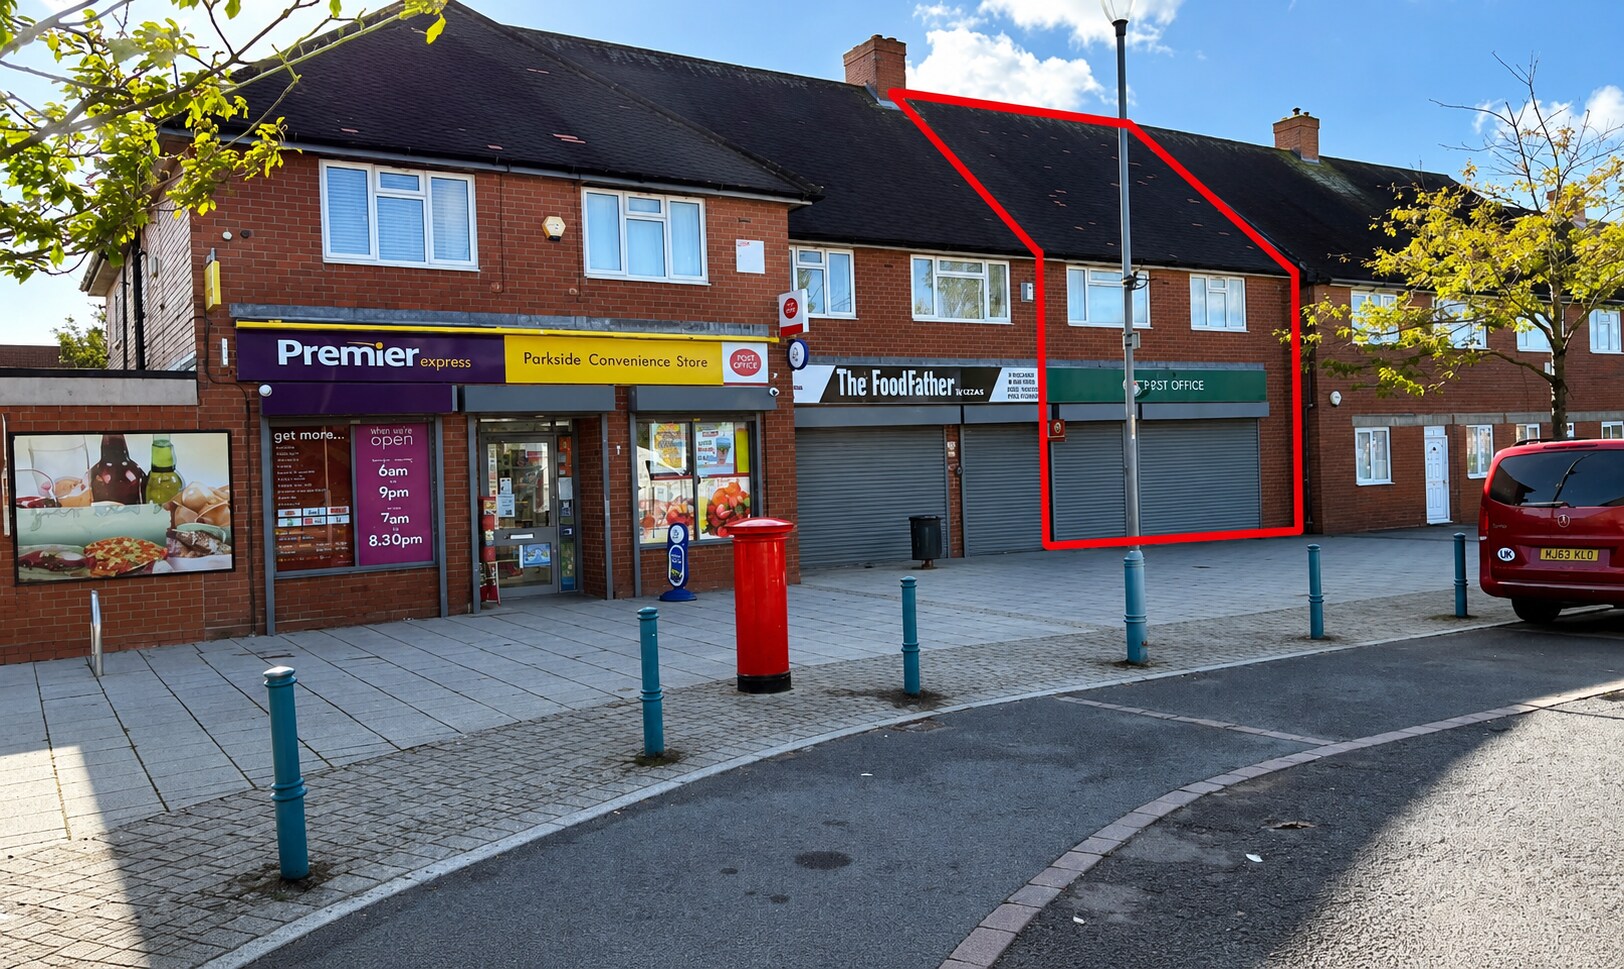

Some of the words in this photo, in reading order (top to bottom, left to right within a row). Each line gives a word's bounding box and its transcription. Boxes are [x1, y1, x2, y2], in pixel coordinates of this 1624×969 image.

[277, 339, 420, 367] Premier
[420, 356, 472, 371] express
[523, 351, 581, 367] Parkside
[588, 353, 671, 368] Convenience
[676, 355, 708, 368] Store
[737, 354, 755, 362] POST
[733, 361, 758, 370] OFFICE
[836, 368, 867, 397] The
[871, 369, 955, 397] FoodFather
[1171, 379, 1204, 391] OFFICE
[274, 431, 296, 443] get
[300, 430, 345, 441] more...
[370, 426, 390, 435] when
[371, 435, 413, 450] open
[378, 464, 408, 477] 6am
[379, 486, 409, 501] 9pm
[380, 512, 410, 525] 7am
[369, 533, 423, 549] 8.30pm
[1500, 550, 1512, 559] UK
